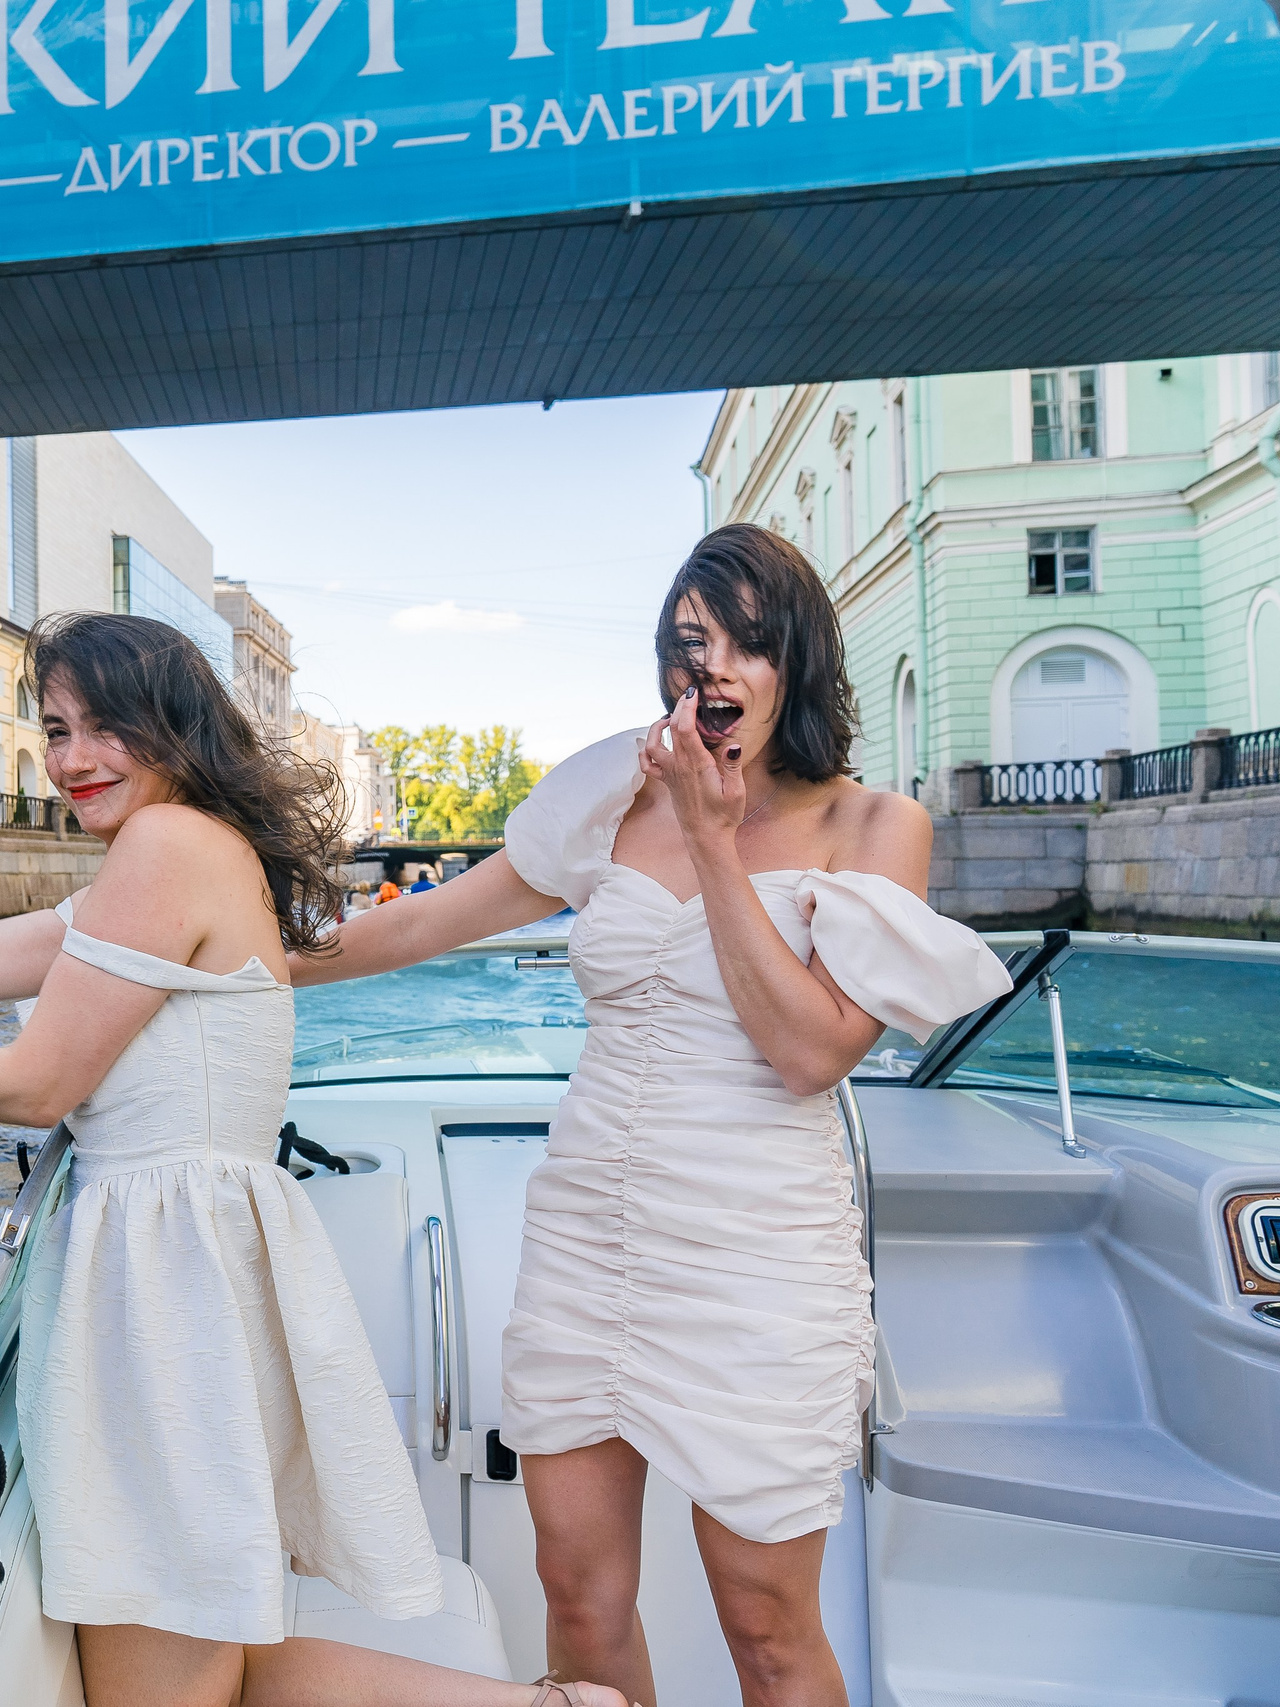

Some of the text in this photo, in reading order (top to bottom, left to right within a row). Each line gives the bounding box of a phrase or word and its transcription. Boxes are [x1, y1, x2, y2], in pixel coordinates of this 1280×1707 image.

[64, 119, 379, 197] ДИРЕКТОР
[489, 60, 806, 153] ВАЛЕРИЙ
[831, 39, 1128, 119] ГЕРГИЕВ
